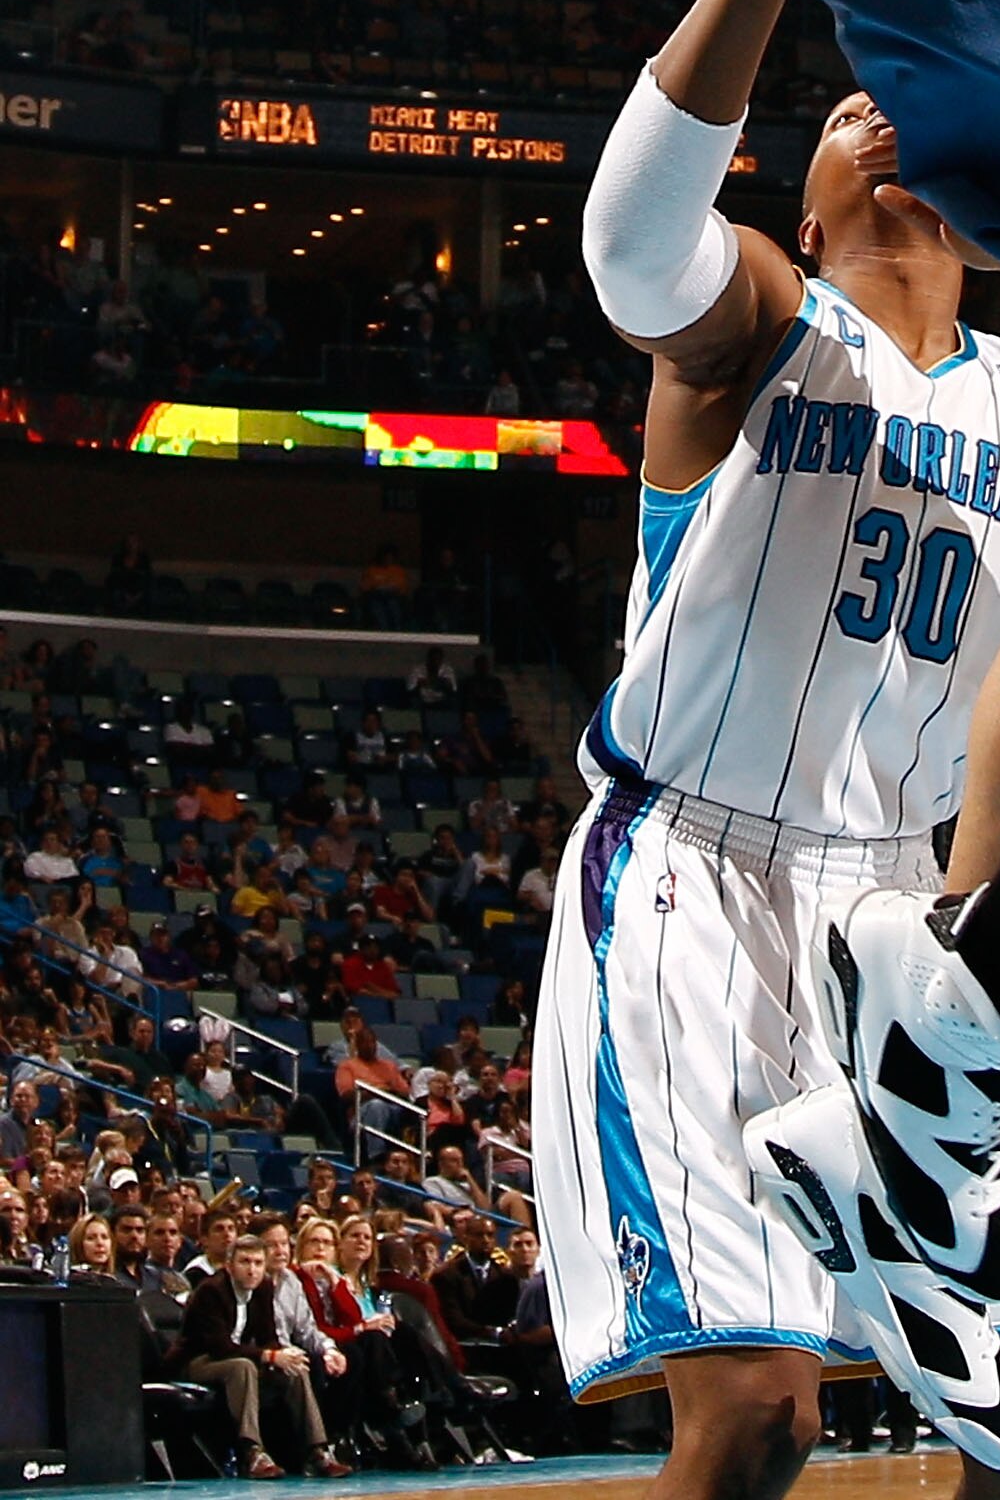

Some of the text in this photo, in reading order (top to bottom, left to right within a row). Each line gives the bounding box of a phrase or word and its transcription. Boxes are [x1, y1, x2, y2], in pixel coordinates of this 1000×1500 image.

[0, 92, 62, 129] er
[240, 100, 318, 145] NBA
[371, 105, 499, 133] MIAMI HEAT
[370, 131, 565, 162] DETROIT PISTONS
[728, 154, 759, 174] ND
[756, 395, 880, 475] NEW
[833, 507, 976, 665] 30
